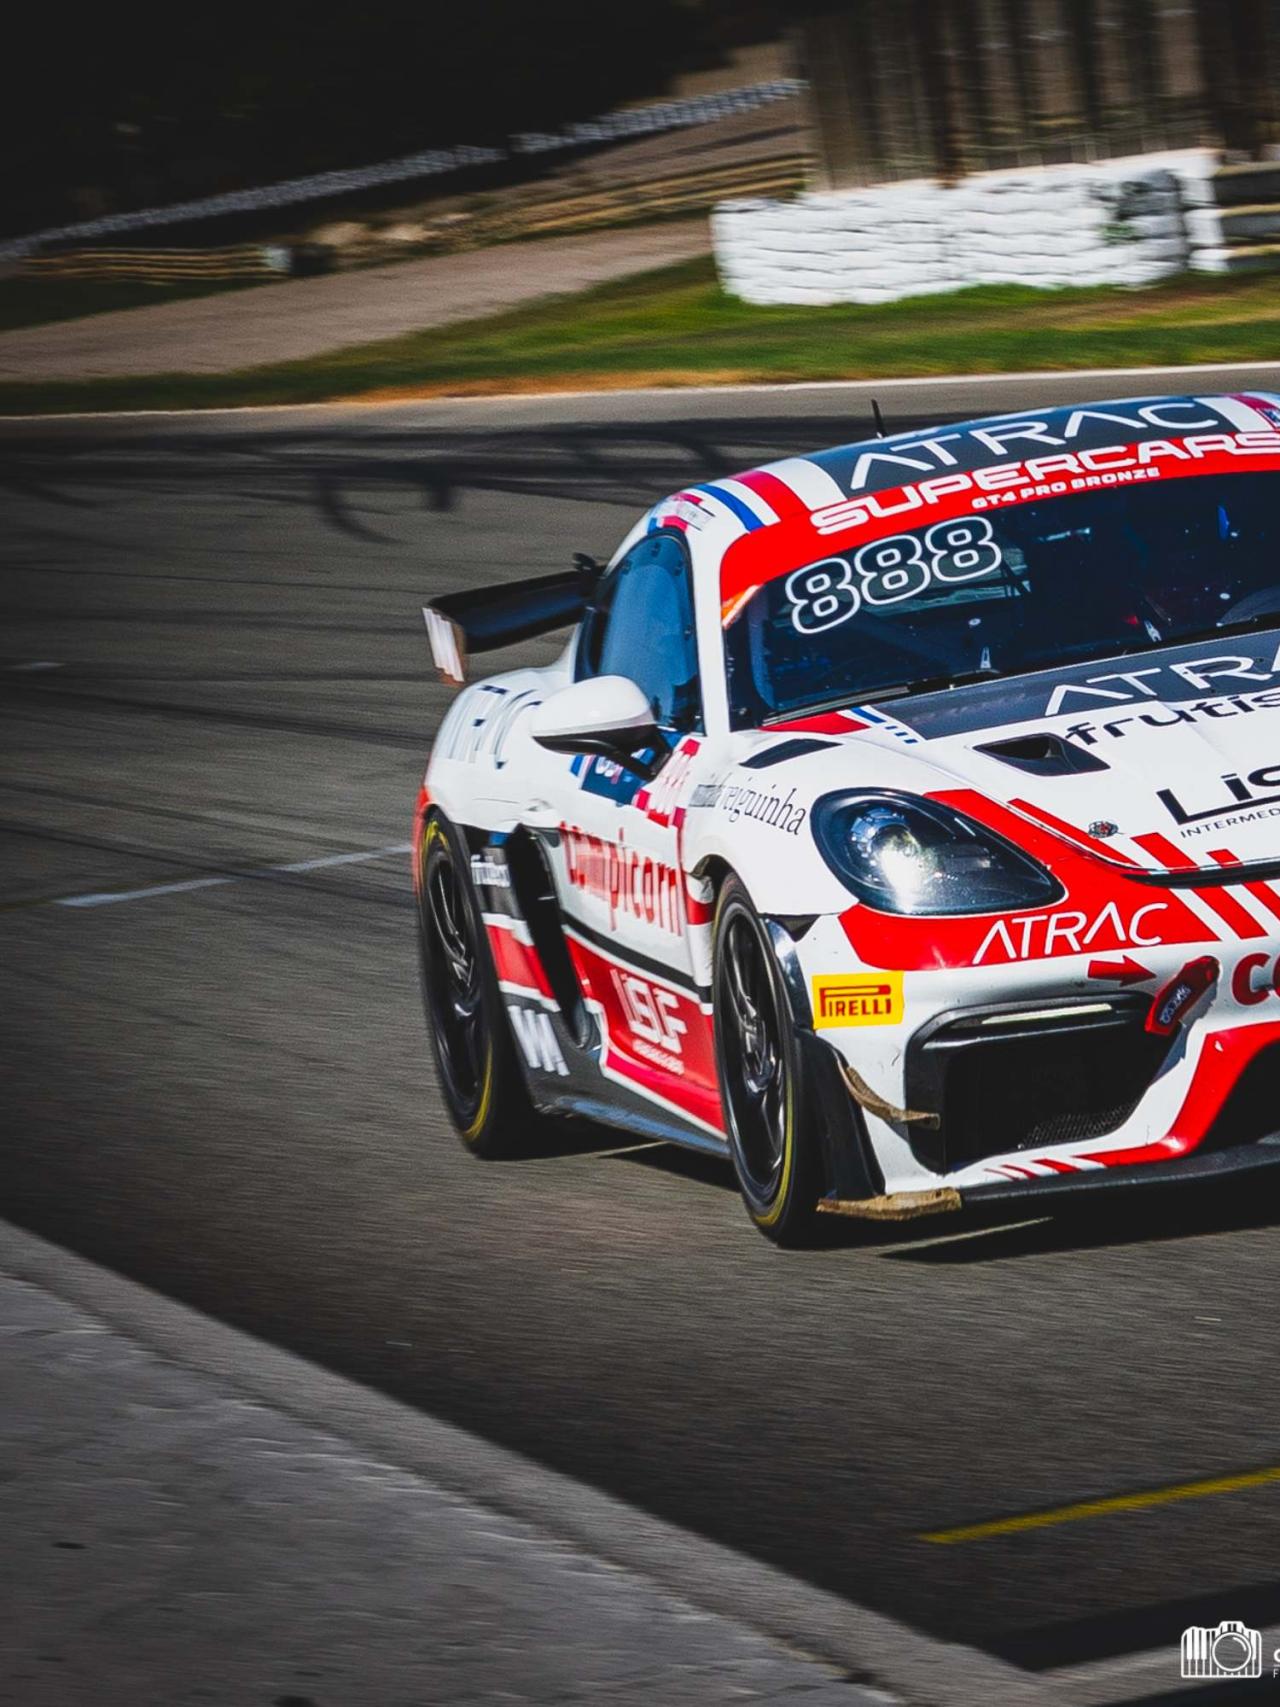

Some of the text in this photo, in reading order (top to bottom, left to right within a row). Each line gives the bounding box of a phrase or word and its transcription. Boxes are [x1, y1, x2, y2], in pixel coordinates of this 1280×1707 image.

[850, 400, 1219, 490] ATRAC
[971, 467, 1160, 509] GT4 PRO BRONZE
[784, 516, 1003, 634] 888
[972, 901, 1169, 965] ATRAC
[819, 984, 892, 1018] PIRELLI
